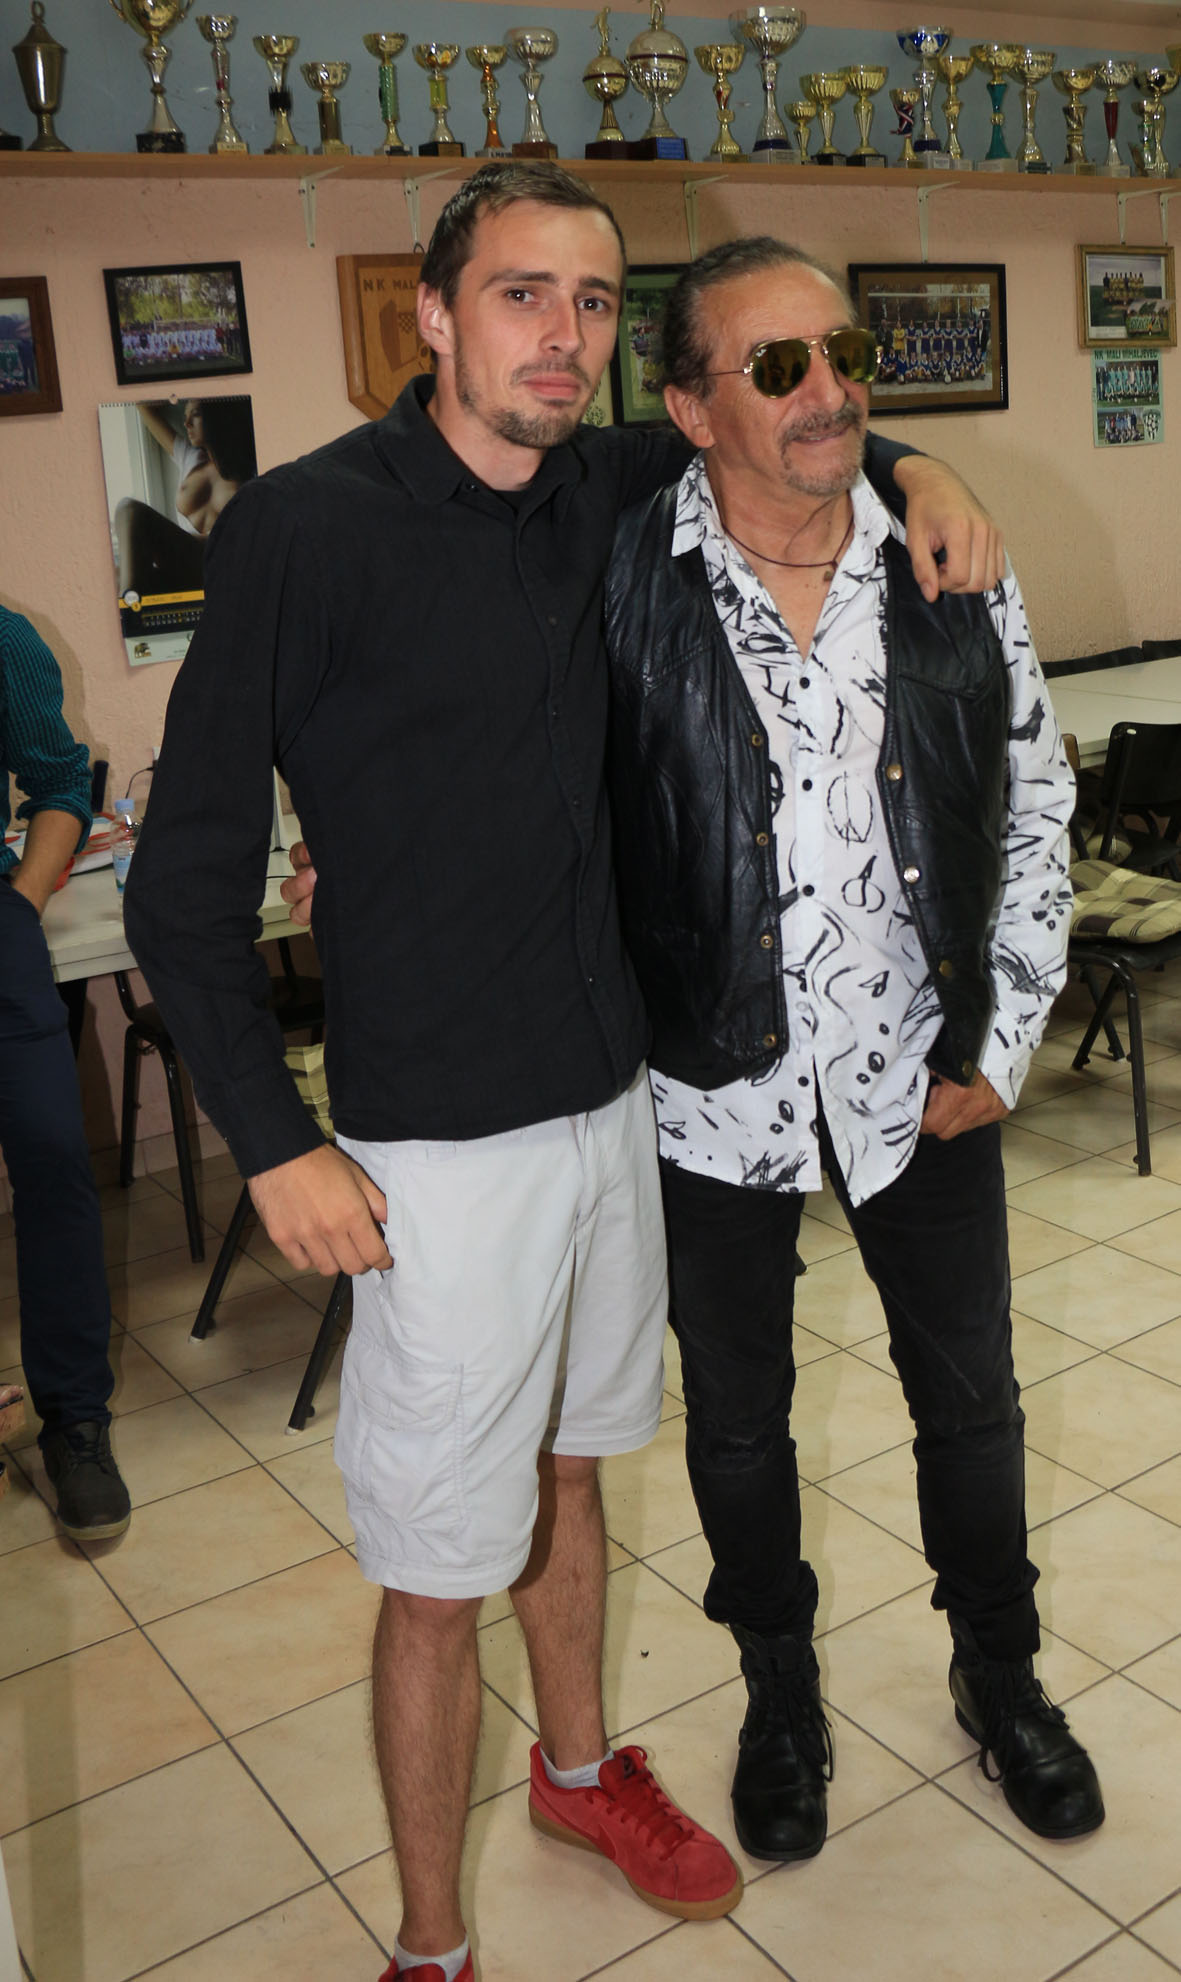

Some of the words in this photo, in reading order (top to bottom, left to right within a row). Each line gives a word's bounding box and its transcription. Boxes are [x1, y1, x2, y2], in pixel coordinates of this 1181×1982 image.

[363, 279, 384, 291] NK
[1094, 350, 1104, 360] NK
[1106, 349, 1121, 359] MALI
